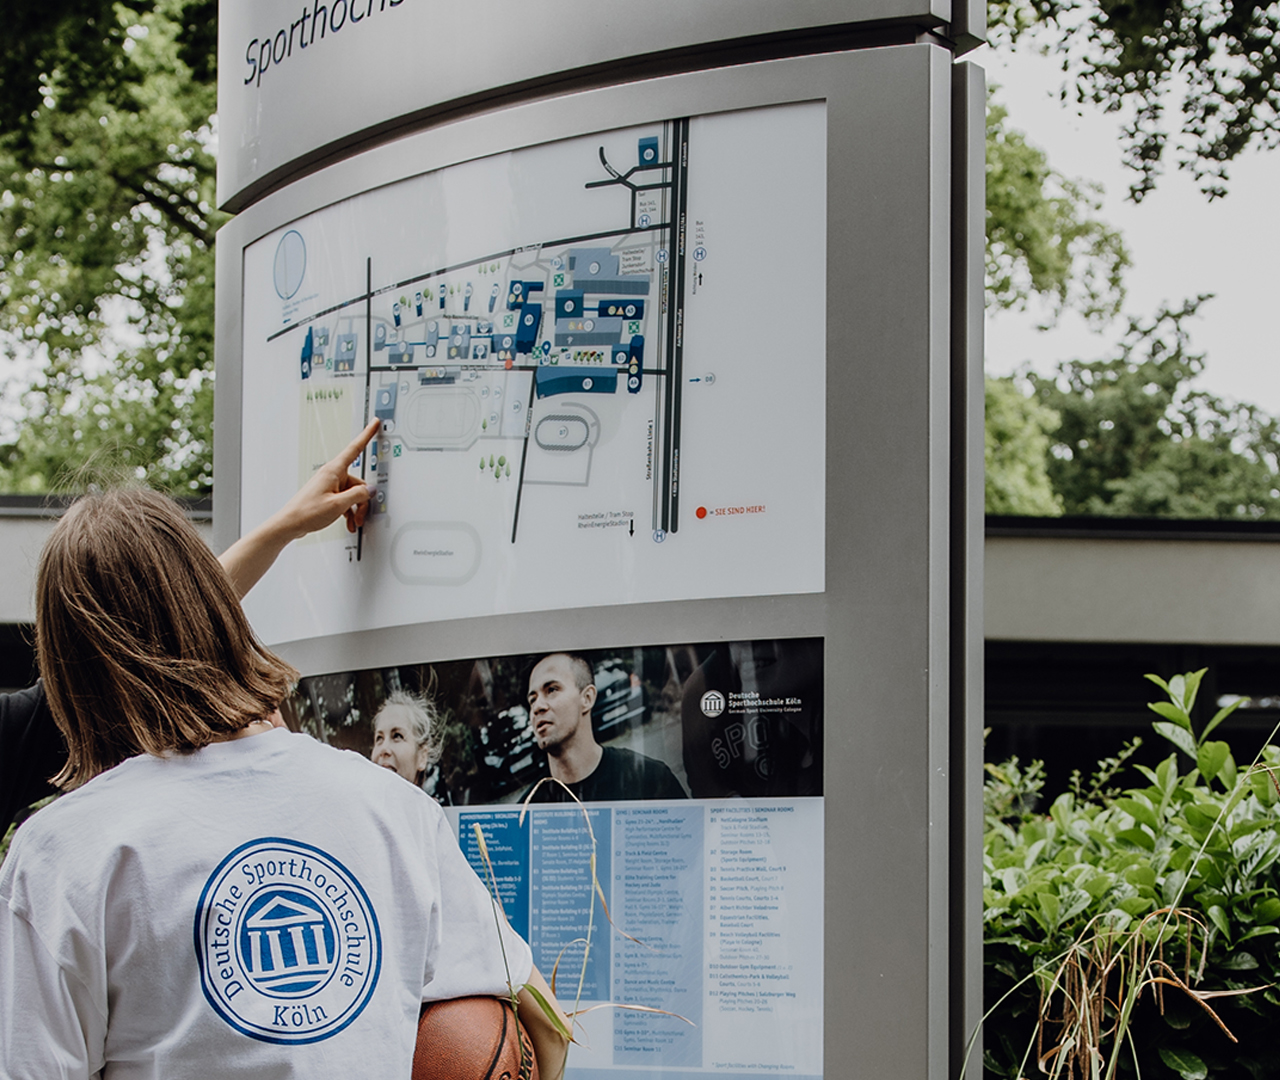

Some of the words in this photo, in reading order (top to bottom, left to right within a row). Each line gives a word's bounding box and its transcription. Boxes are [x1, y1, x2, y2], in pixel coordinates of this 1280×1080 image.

[244, 0, 404, 88] Sporthoc
[578, 513, 604, 521] Haltestelle
[622, 510, 634, 518] Stop
[715, 508, 726, 516] SIE
[746, 505, 766, 513] HIER!
[728, 698, 784, 708] Sporthochschule
[785, 697, 802, 705] Köln
[211, 884, 244, 1001] Deutsche
[242, 859, 366, 987] Sporthochschule
[272, 1004, 328, 1027] Köln
